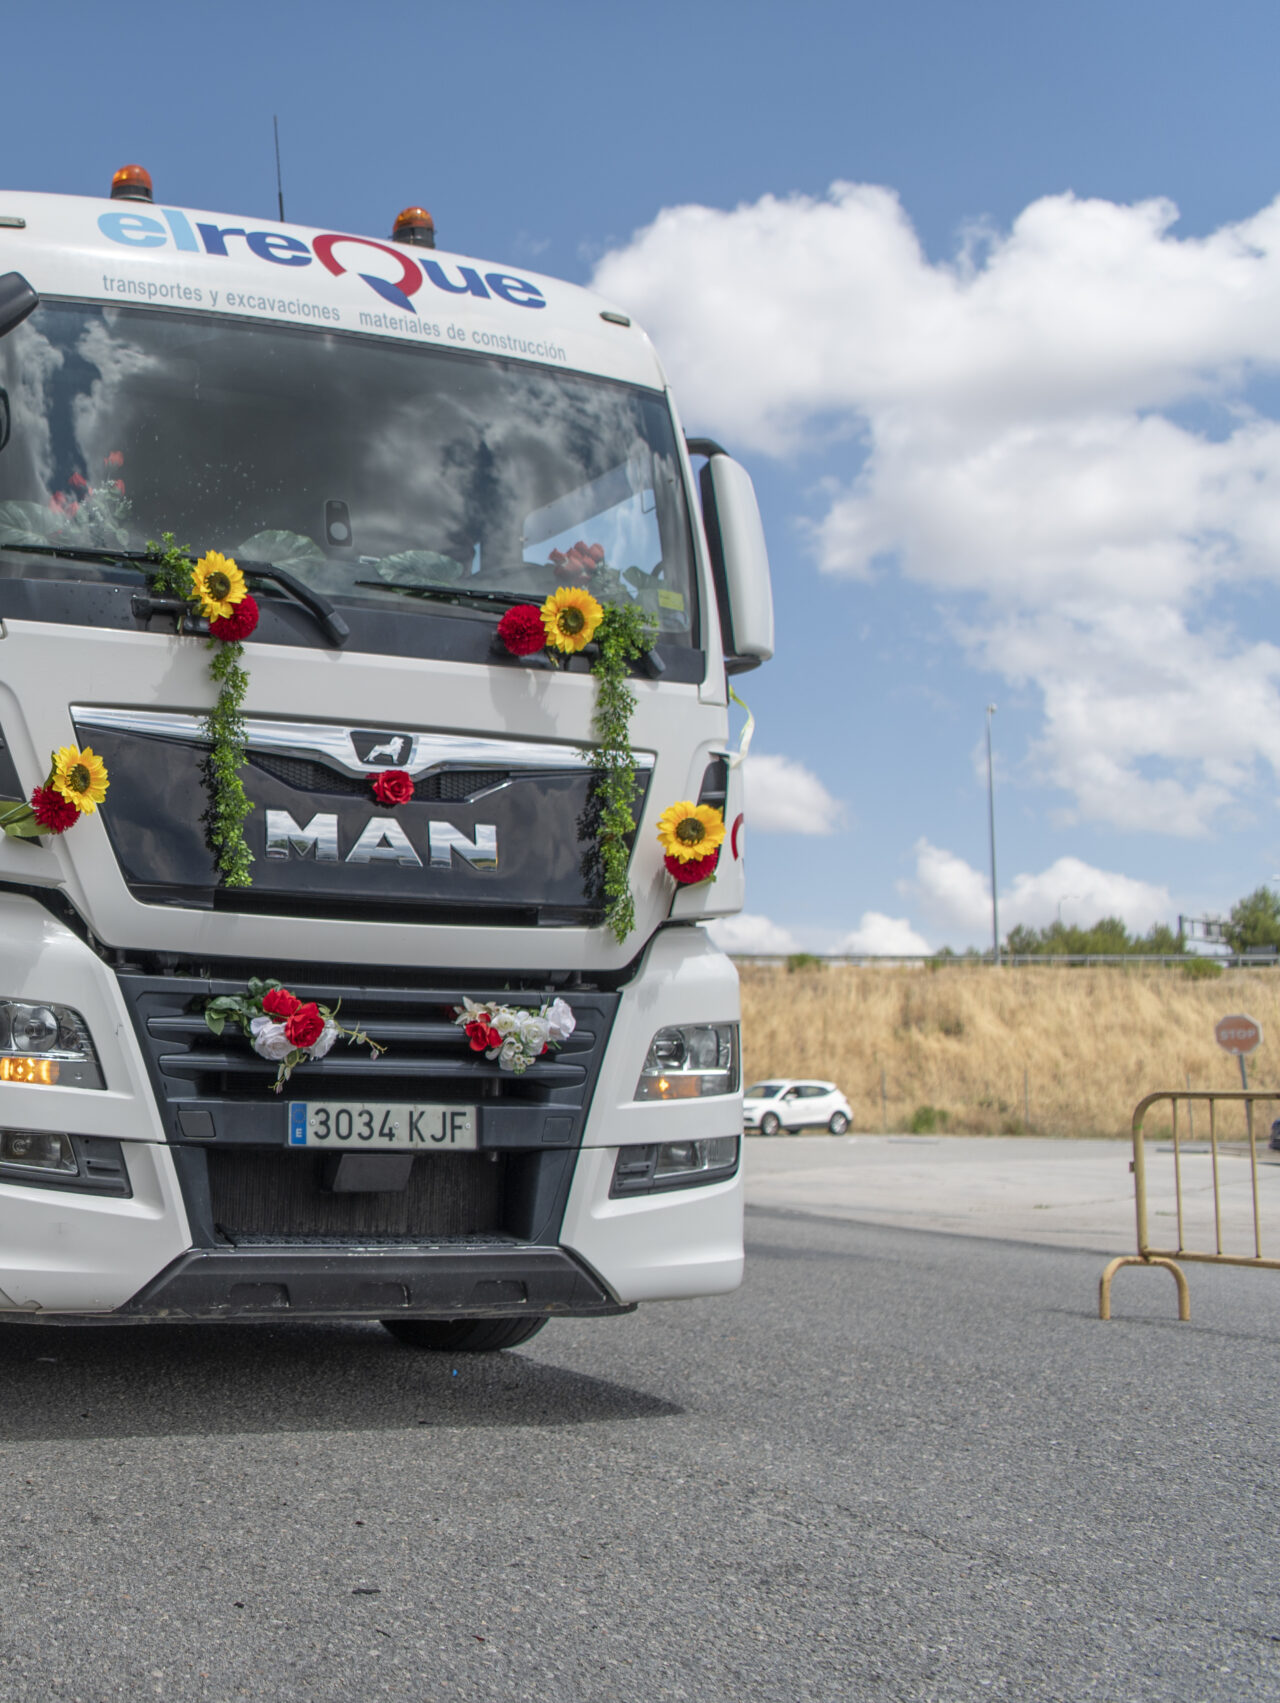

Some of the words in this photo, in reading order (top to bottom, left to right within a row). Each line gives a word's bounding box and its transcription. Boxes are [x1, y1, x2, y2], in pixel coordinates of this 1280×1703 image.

[102, 274, 203, 301] transportes
[209, 289, 219, 307] y
[226, 291, 340, 321] excavaciones
[359, 311, 441, 338] materiales
[447, 323, 466, 342] de
[472, 330, 568, 362] construcción
[265, 808, 498, 873] MAN
[1220, 1029, 1256, 1041] STOP
[313, 1107, 396, 1142] 3034
[409, 1110, 468, 1144] KJF
